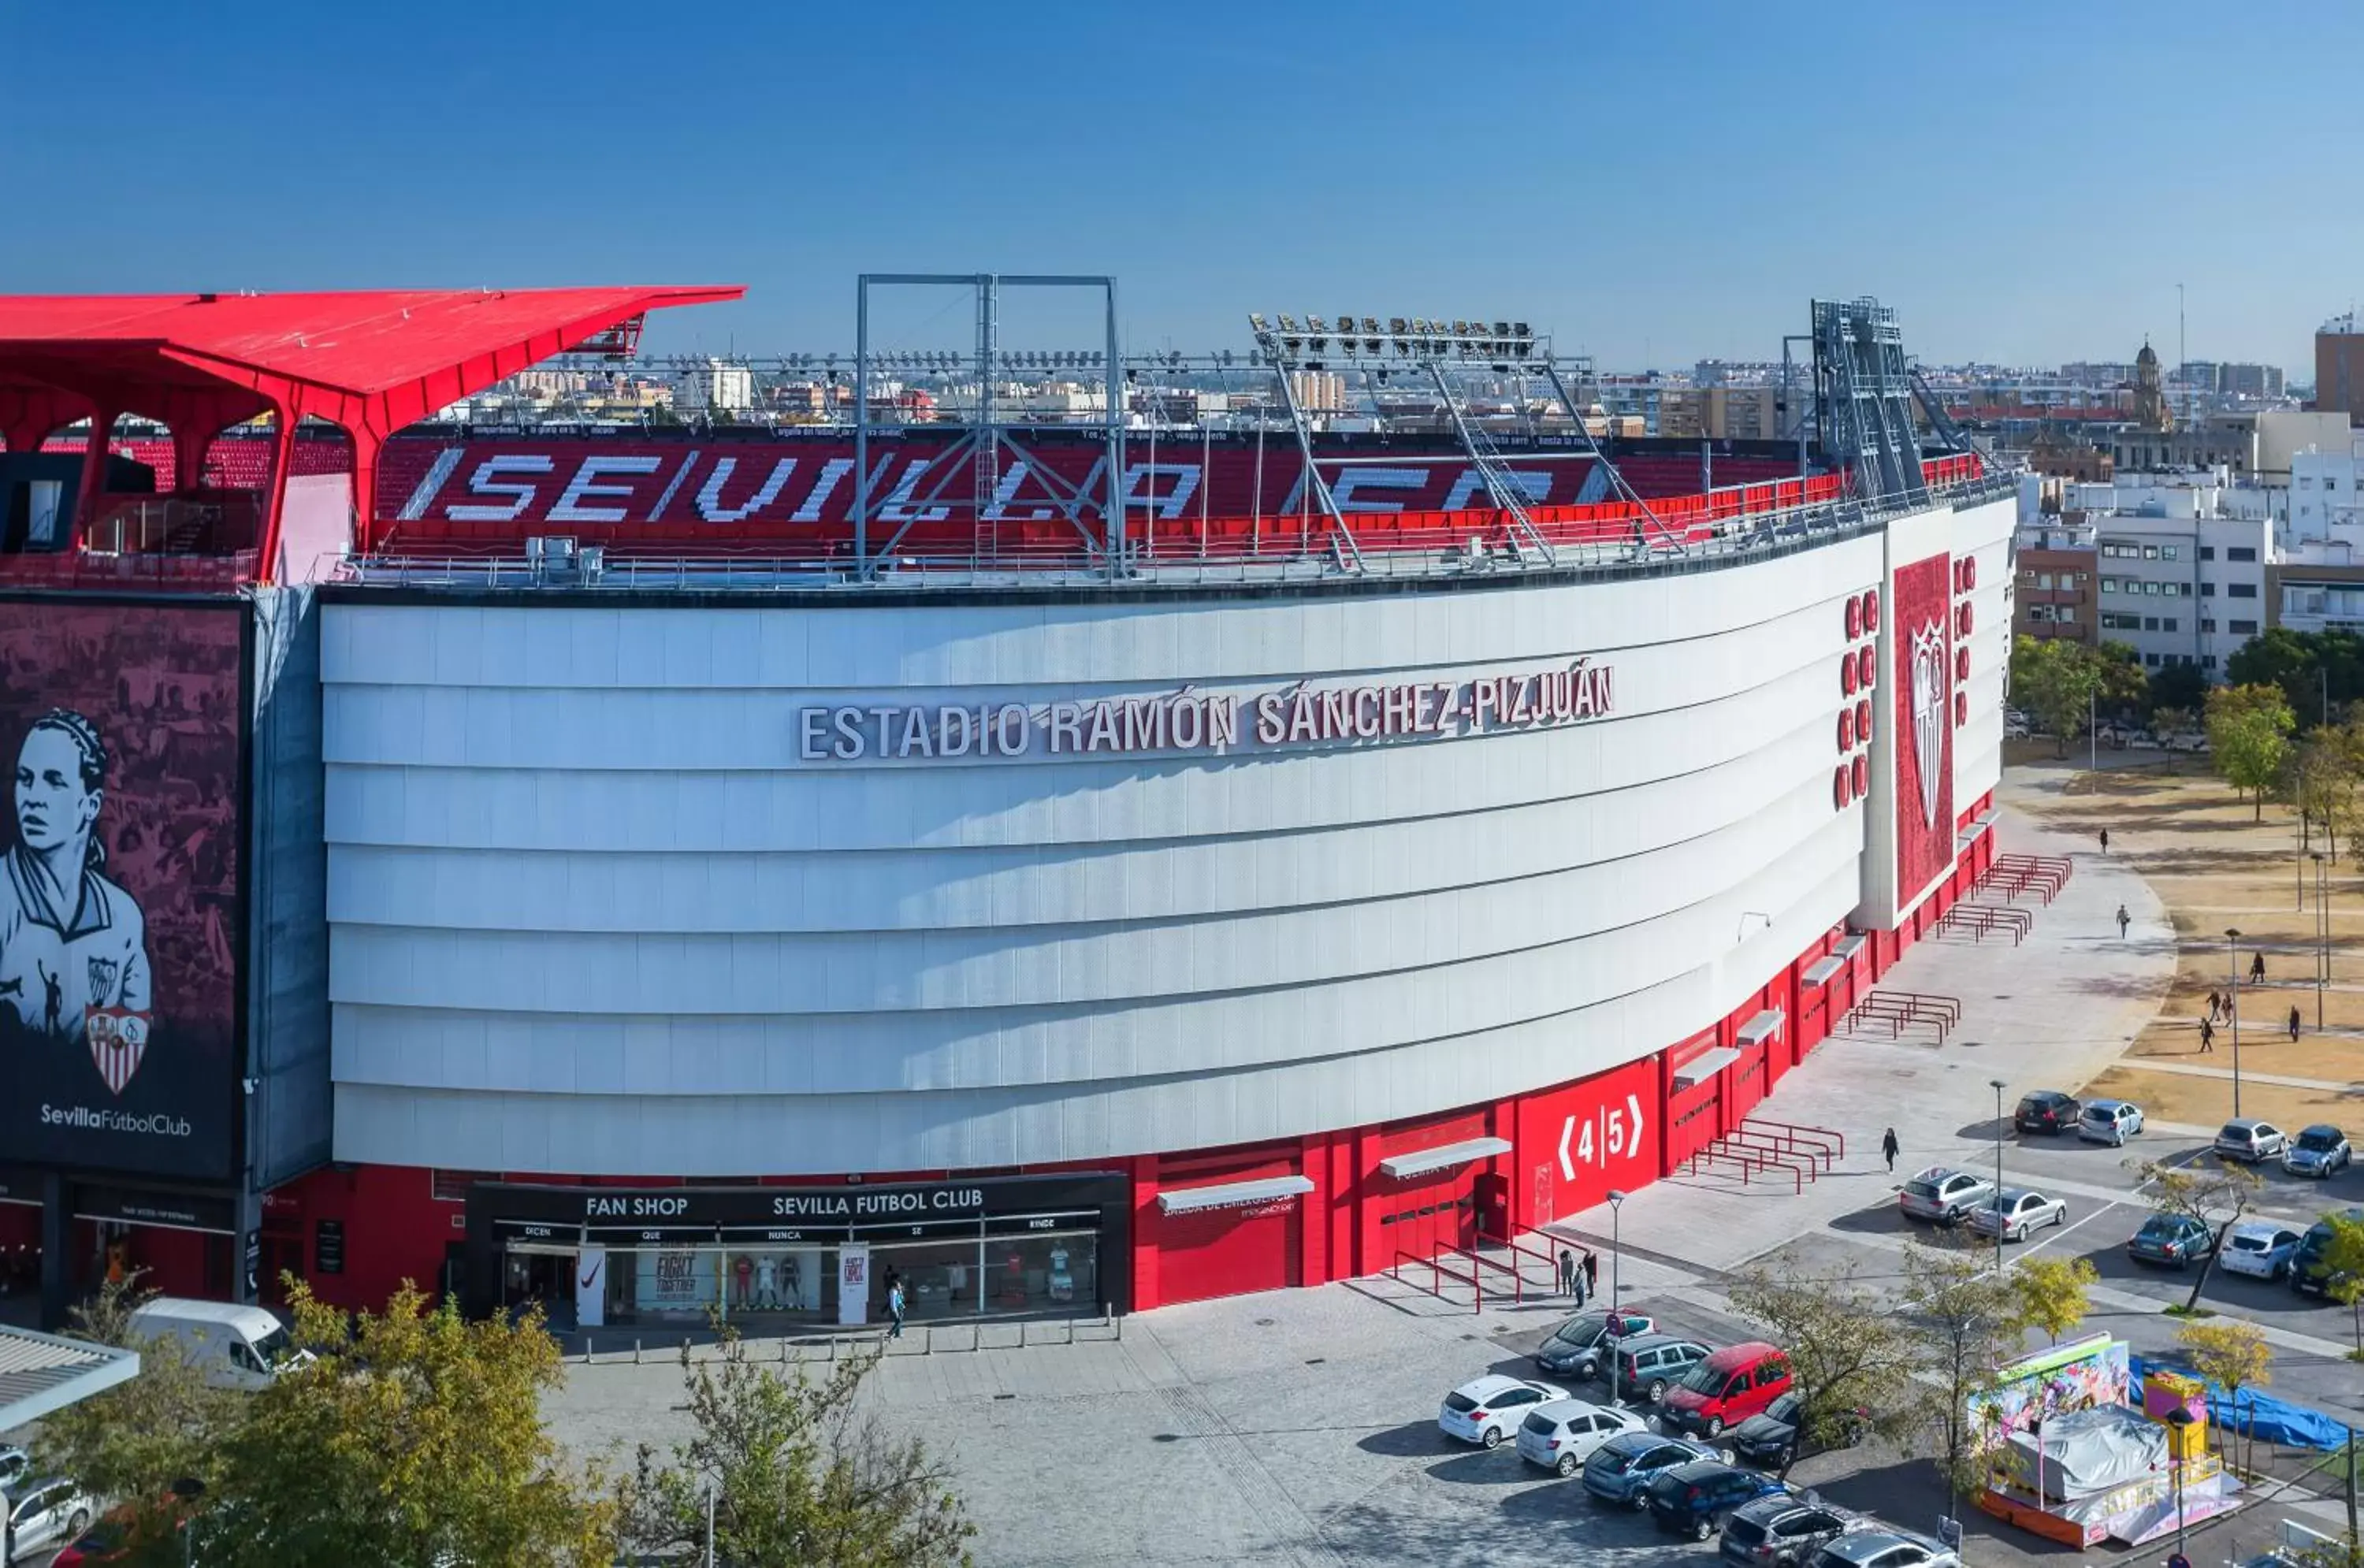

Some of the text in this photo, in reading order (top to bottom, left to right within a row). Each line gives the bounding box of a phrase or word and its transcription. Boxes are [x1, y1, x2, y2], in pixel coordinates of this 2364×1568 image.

[801, 657, 1615, 760] ESTADIO RAMÓN SÁNCHEZ-PIZJUÁN
[586, 1197, 688, 1216] FAN SHOP
[772, 1188, 983, 1215] SEVILLA FUTBOL CLUB
[525, 1226, 552, 1236] DICEN
[642, 1231, 661, 1240] QUE
[768, 1231, 801, 1240] NUNCA
[911, 1226, 922, 1235] SE
